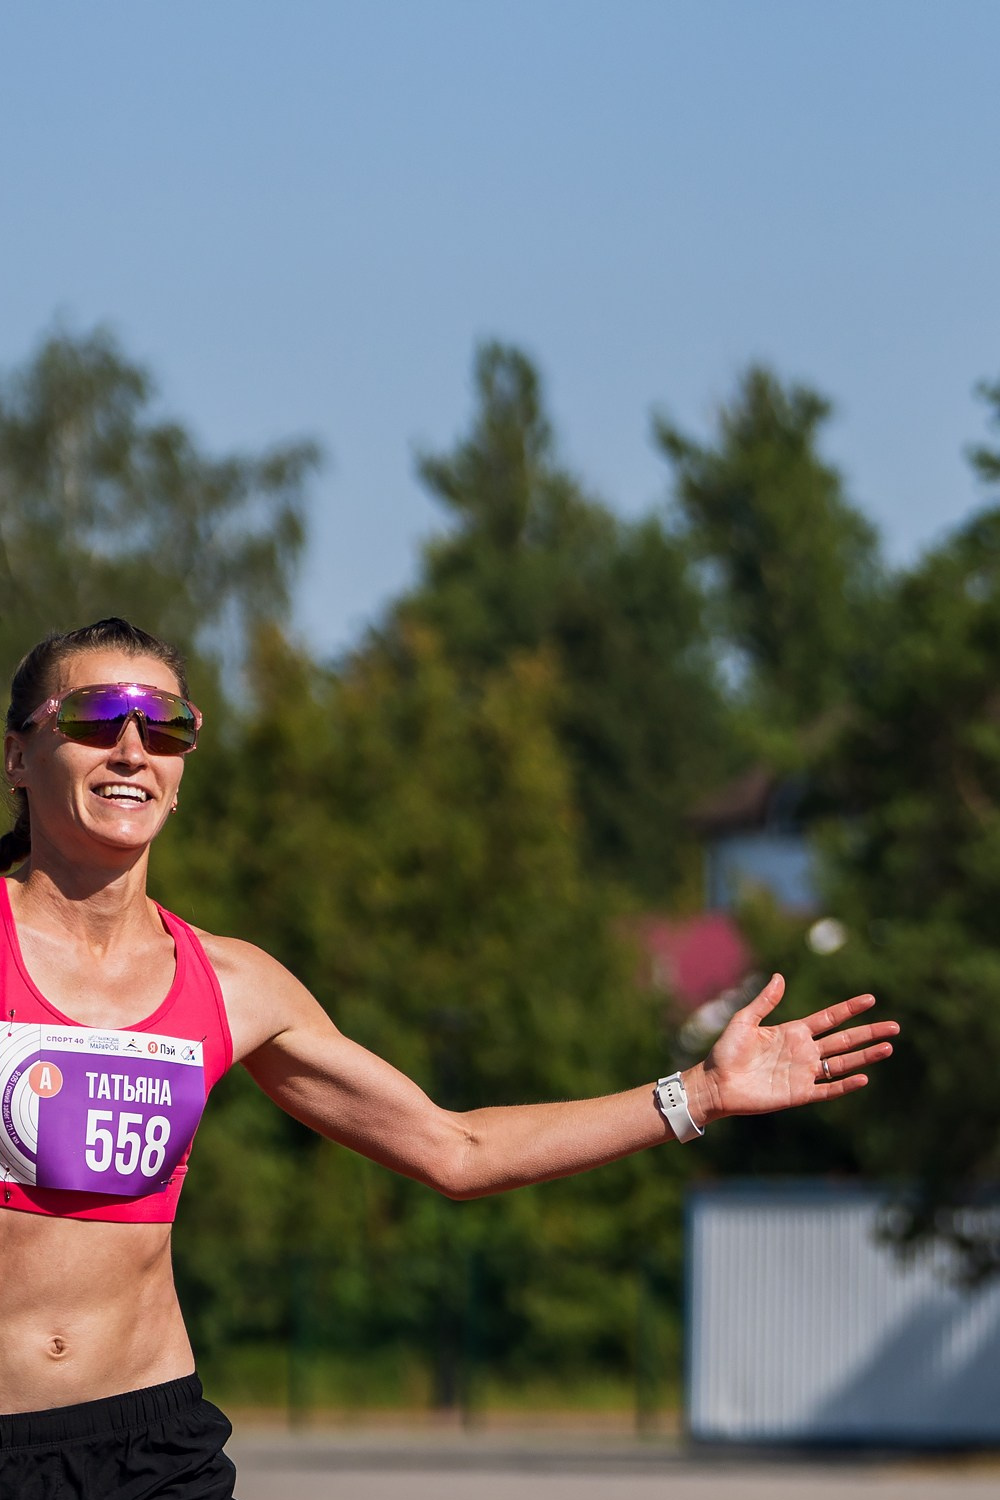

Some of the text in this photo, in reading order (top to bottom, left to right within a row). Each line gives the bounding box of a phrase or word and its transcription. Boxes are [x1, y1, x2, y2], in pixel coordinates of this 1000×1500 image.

[46, 1035, 84, 1045] СПОРТ 40
[160, 1043, 176, 1056] Пэй
[85, 1071, 172, 1107] ТАТЬЯНА
[85, 1108, 171, 1177] 558
